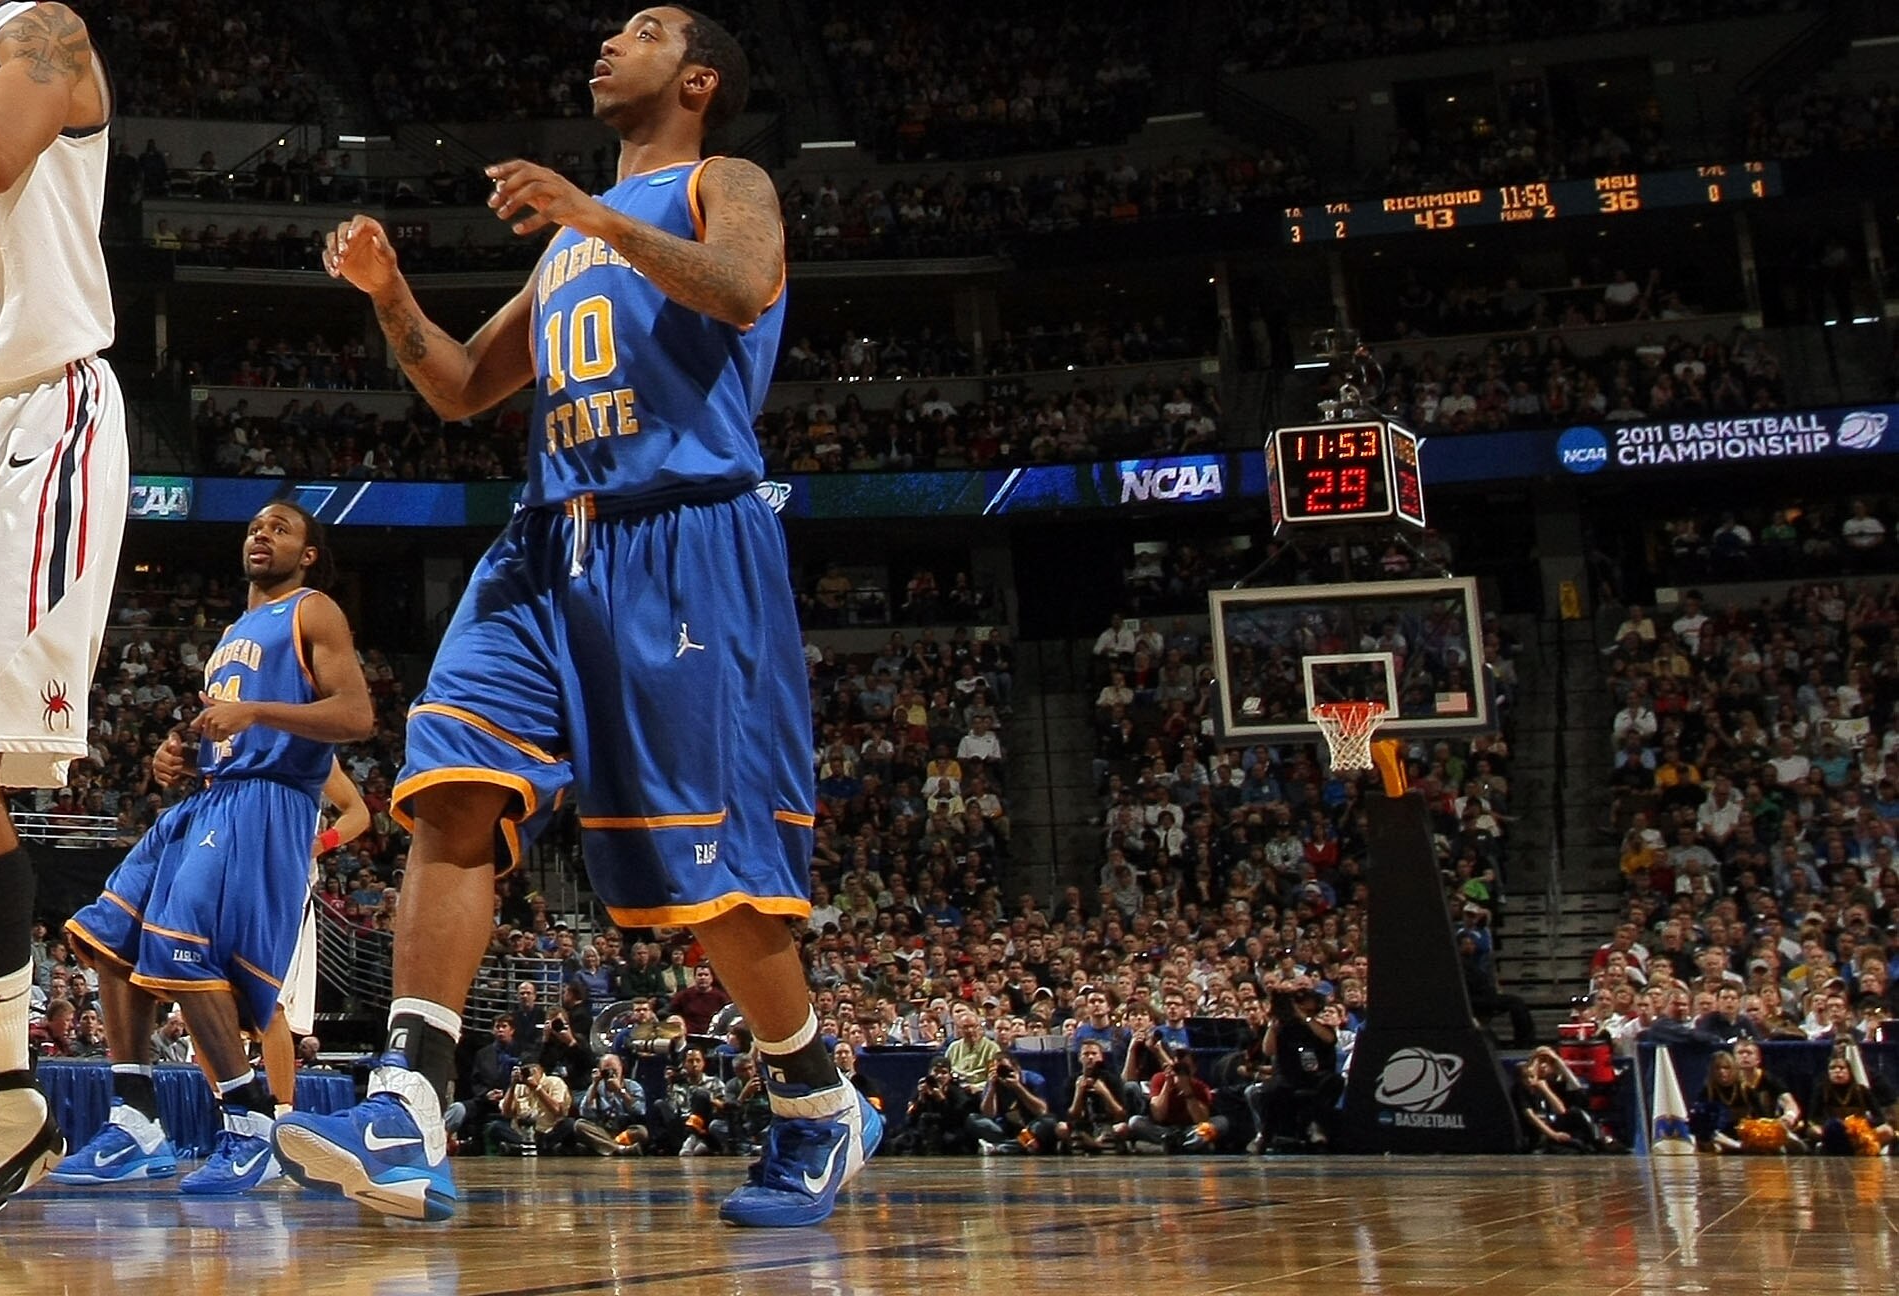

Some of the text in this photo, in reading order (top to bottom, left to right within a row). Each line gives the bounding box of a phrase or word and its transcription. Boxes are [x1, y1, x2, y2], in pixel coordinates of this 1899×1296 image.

[1595, 174, 1638, 191] MSU
[1383, 189, 1482, 212] RICHMOND
[1499, 183, 1549, 209] 11:53
[1598, 190, 1641, 214] 36
[1414, 208, 1455, 230] 43
[1543, 204, 1556, 219] 2
[1335, 220, 1347, 239] 2
[544, 294, 617, 396] 10
[545, 388, 640, 456] STATE
[1616, 414, 1827, 446] 2011 BASKETBALL
[1296, 430, 1377, 462] 11:53
[1563, 447, 1607, 464] NCAA
[1617, 433, 1831, 467] CHAMPIONSHIP
[1120, 463, 1222, 504] NCAA
[1305, 468, 1367, 512] 29
[131, 486, 190, 518] CAA
[1395, 1112, 1466, 1129] BASKETBALL
